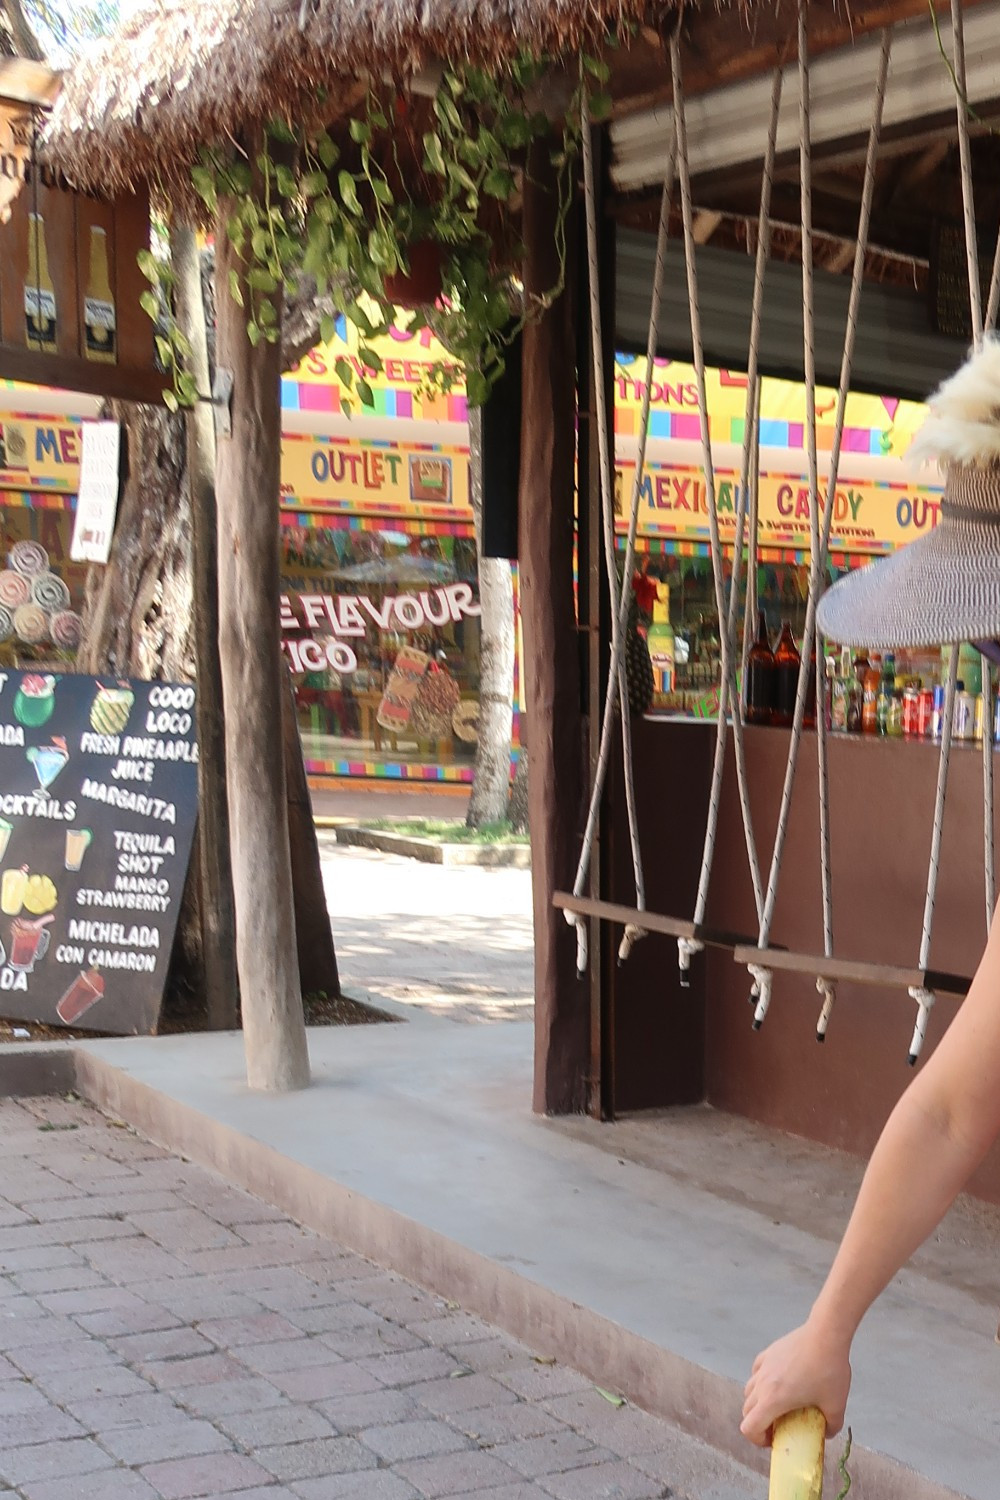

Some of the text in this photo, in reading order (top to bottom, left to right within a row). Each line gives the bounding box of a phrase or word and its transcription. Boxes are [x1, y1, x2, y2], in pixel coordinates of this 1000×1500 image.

[35, 427, 82, 465] ME
[311, 449, 402, 491] OUTLET
[299, 582, 482, 638] FLAVOUR
[281, 638, 358, 674] ICO
[148, 685, 196, 711] COCO
[145, 710, 192, 735] LOCO
[80, 731, 121, 757] FRESH
[111, 760, 155, 782] JUICE
[80, 778, 177, 825] MARGARITA
[113, 830, 176, 856] TEQUILA
[117, 853, 165, 875] SHOT
[114, 874, 171, 895] MANGO
[75, 887, 171, 912] STRAWBERRY
[68, 918, 160, 949] MICHELADA
[55, 945, 157, 973] CON CAMARON
